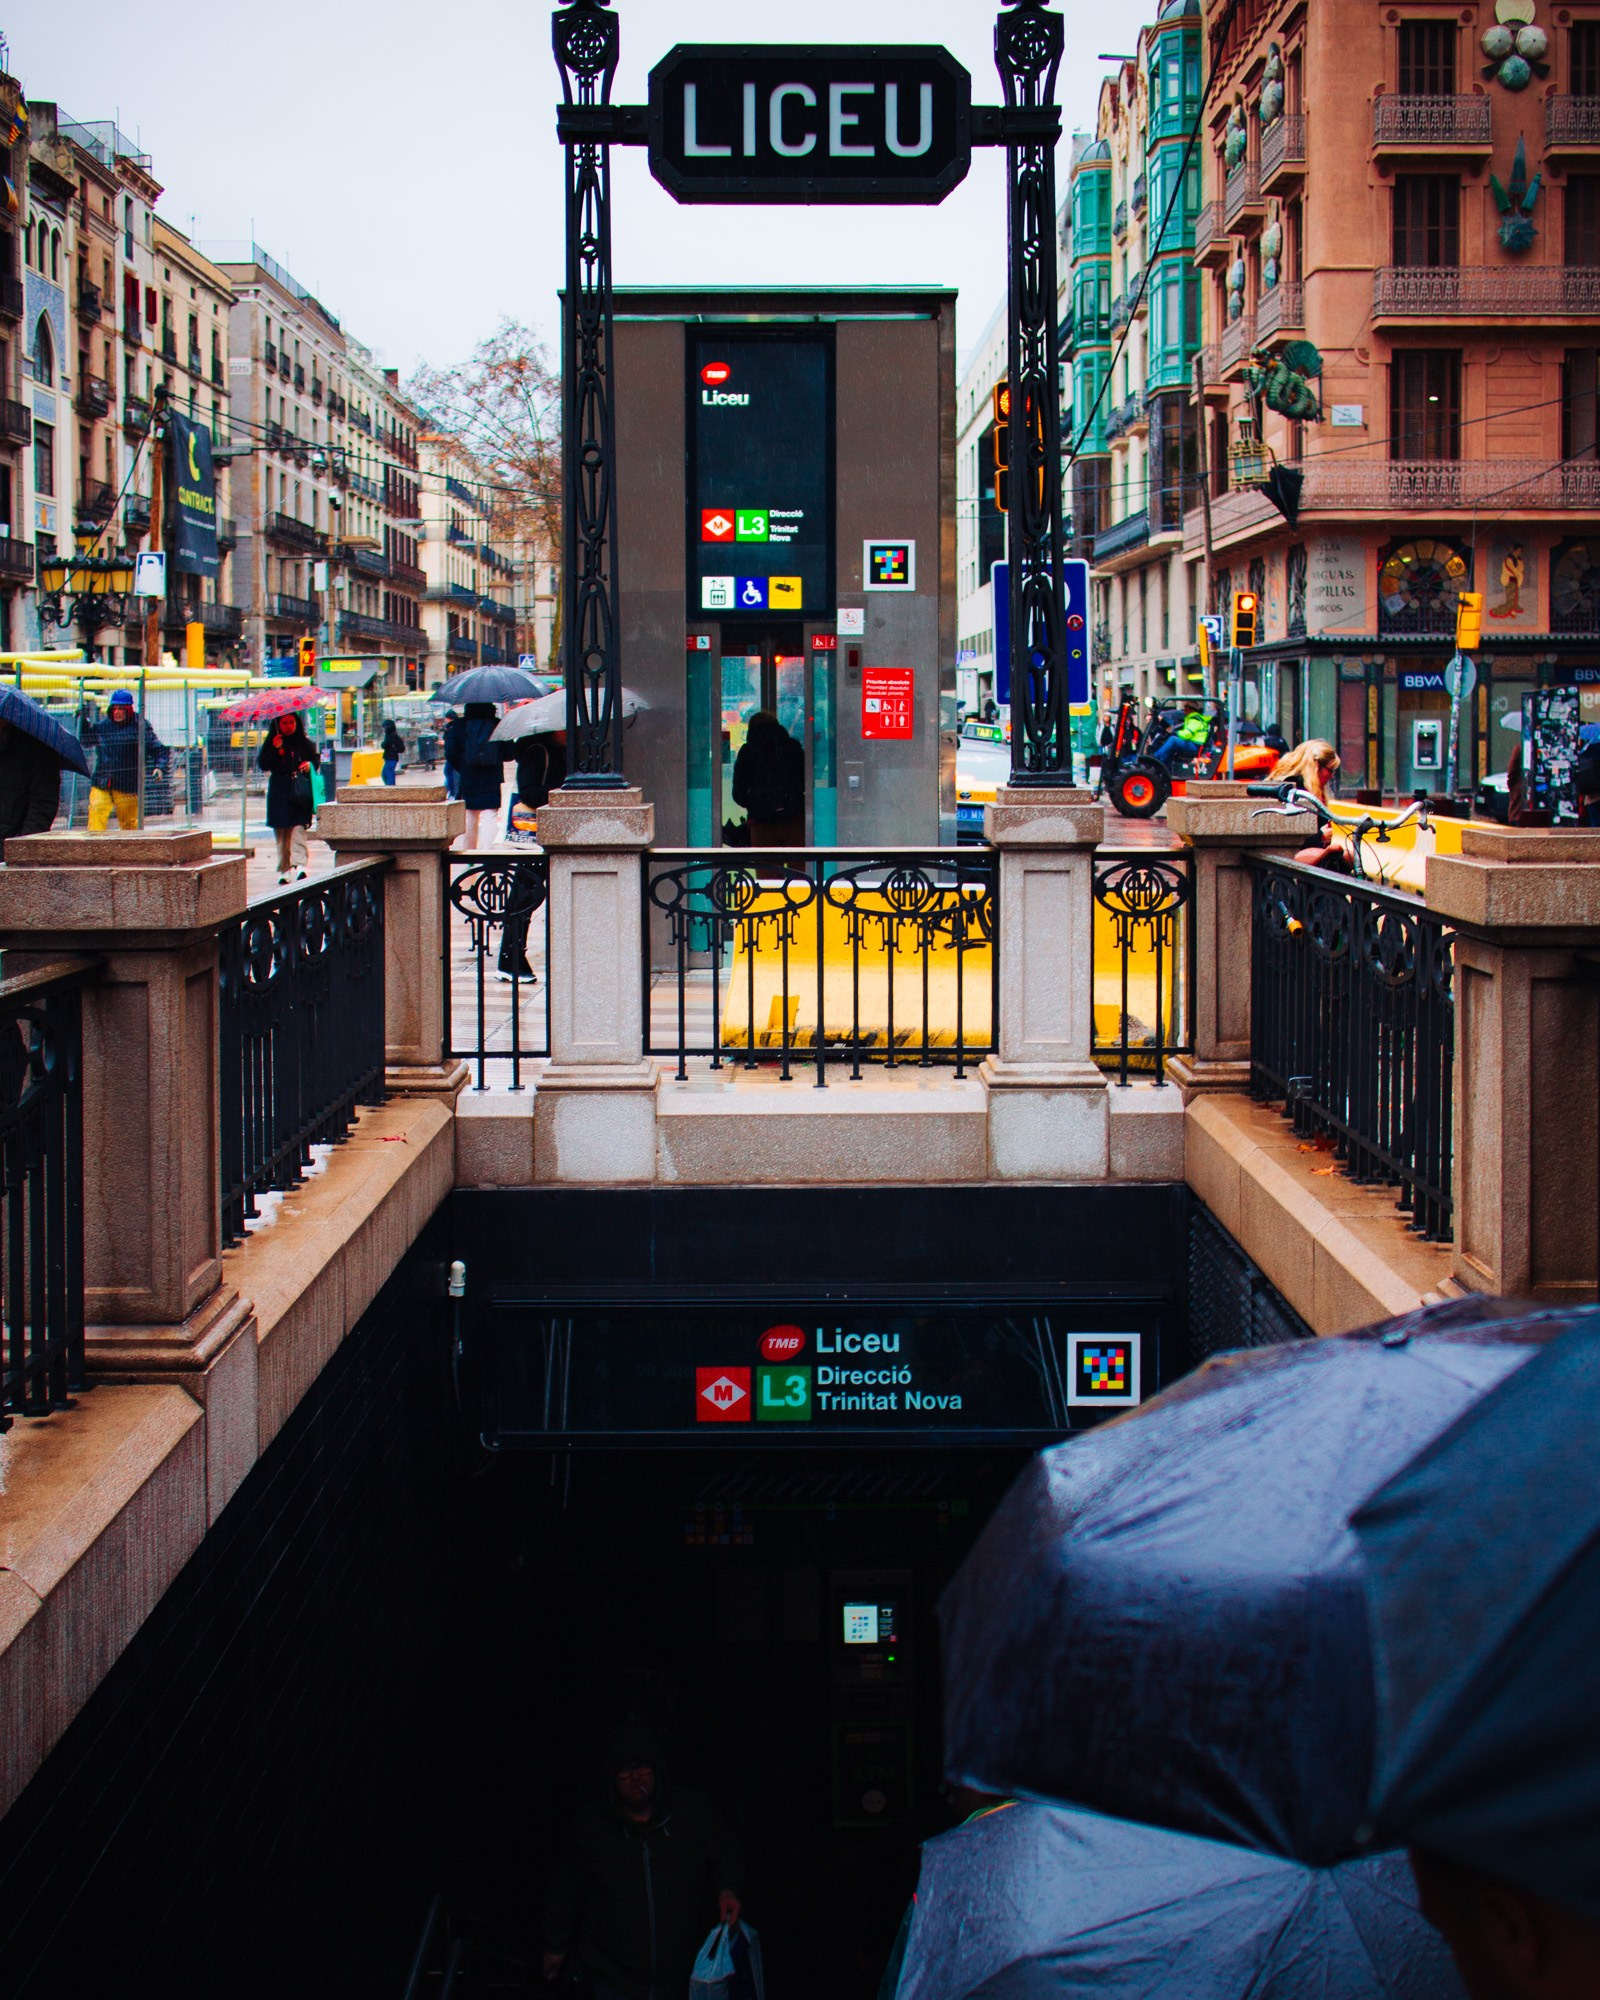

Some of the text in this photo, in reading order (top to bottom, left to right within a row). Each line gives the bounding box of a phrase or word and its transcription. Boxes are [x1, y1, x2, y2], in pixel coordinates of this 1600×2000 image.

[683, 82, 933, 157] LICEU
[702, 389, 750, 405] Liceu
[713, 509, 804, 535] M L3 Direcció
[770, 525, 799, 533] Trinitat
[769, 534, 791, 542] Nova
[1404, 675, 1444, 688] BBVA
[976, 726, 994, 738] TAXI
[767, 1327, 900, 1353] TMB Liceu
[817, 1364, 912, 1385] Direcció
[713, 1374, 962, 1411] M L3 Trinitat Nova
